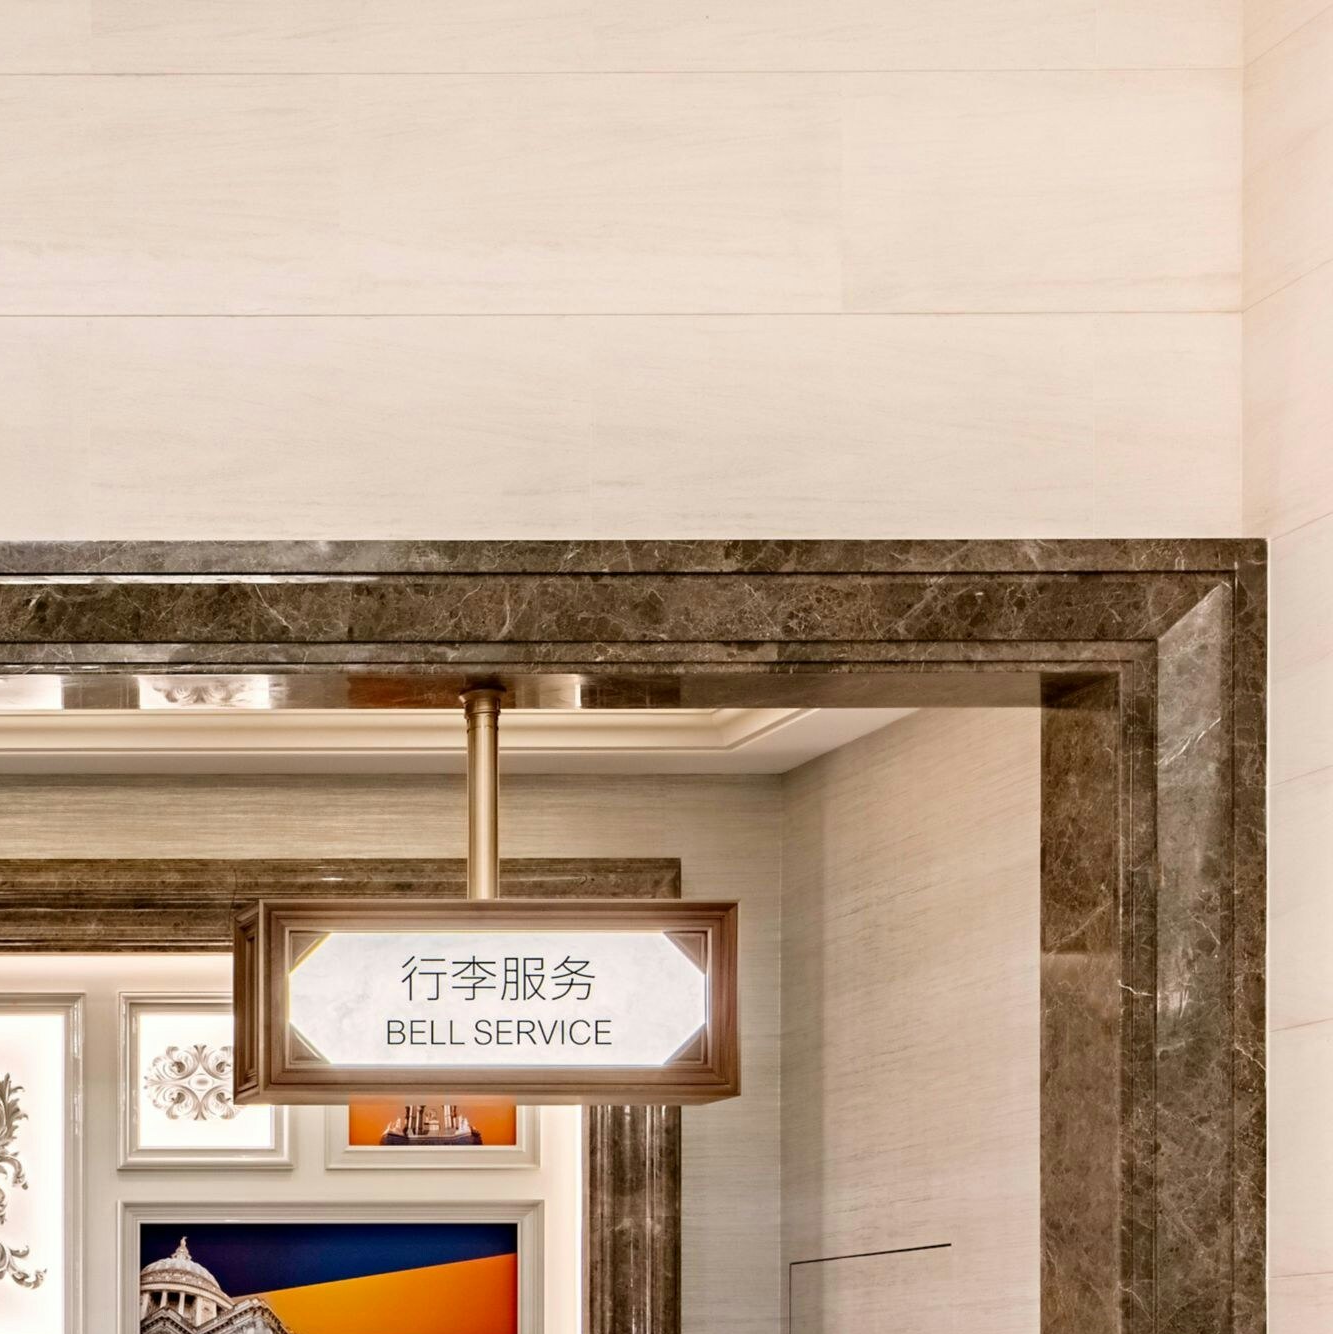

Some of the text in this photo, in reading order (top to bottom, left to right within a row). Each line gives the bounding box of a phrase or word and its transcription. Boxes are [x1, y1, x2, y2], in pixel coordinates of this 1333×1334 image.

[401, 955, 595, 1001] 行李服务
[387, 1019, 612, 1046] BELL SERVICE
